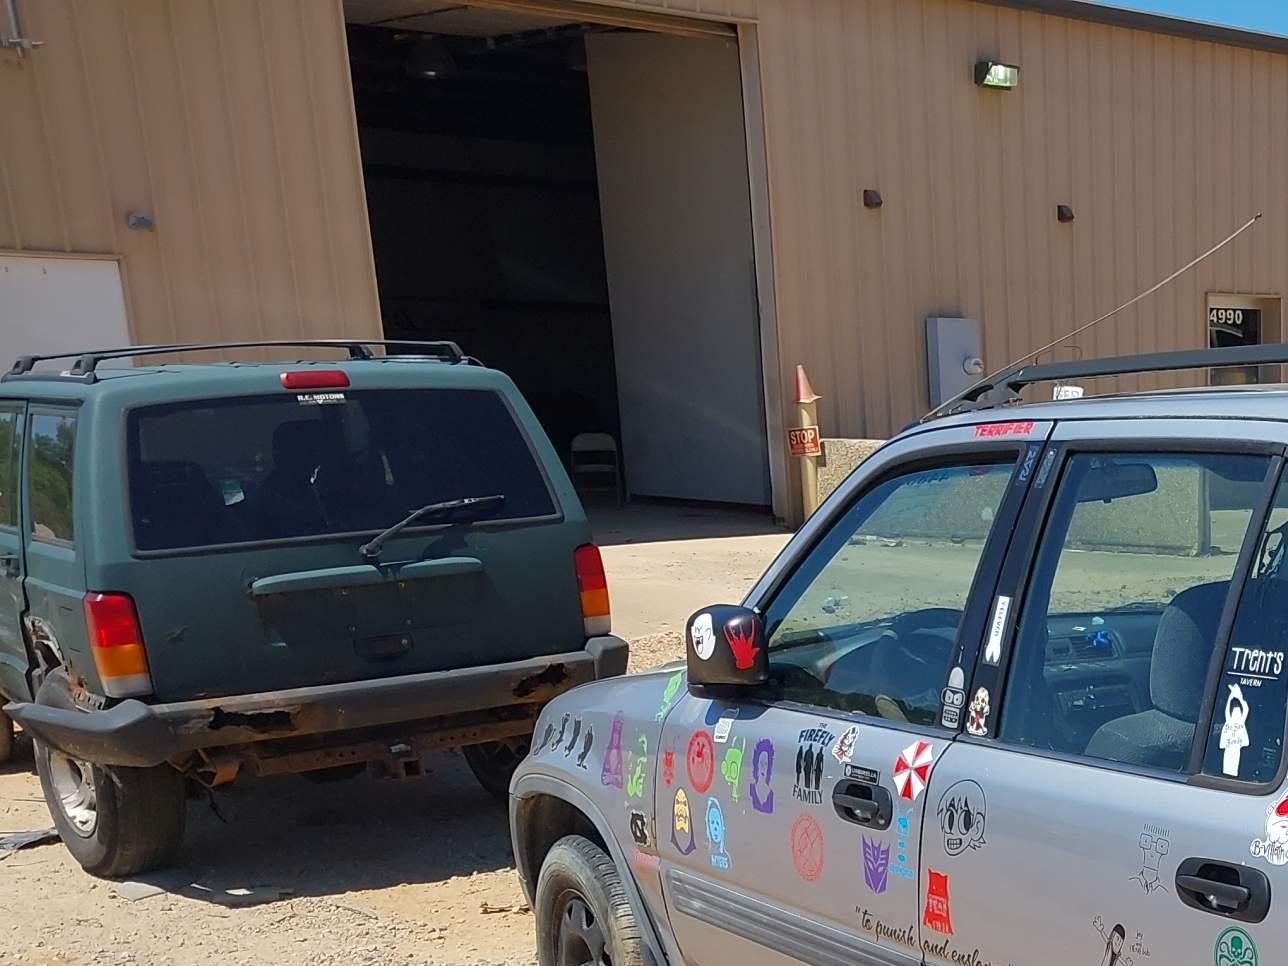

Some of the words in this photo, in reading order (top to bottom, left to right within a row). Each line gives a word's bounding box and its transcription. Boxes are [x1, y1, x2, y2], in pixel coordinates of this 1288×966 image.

[1210, 309, 1243, 325] 4990
[790, 430, 815, 444] STOP
[975, 422, 1034, 437] TERRIFIER
[1232, 647, 1284, 675] Trent's
[1240, 678, 1262, 687] TAVERN
[798, 728, 836, 747] FIREFLY
[792, 784, 824, 804] FAMILY
[876, 920, 916, 946] punish
[923, 939, 950, 959] and
